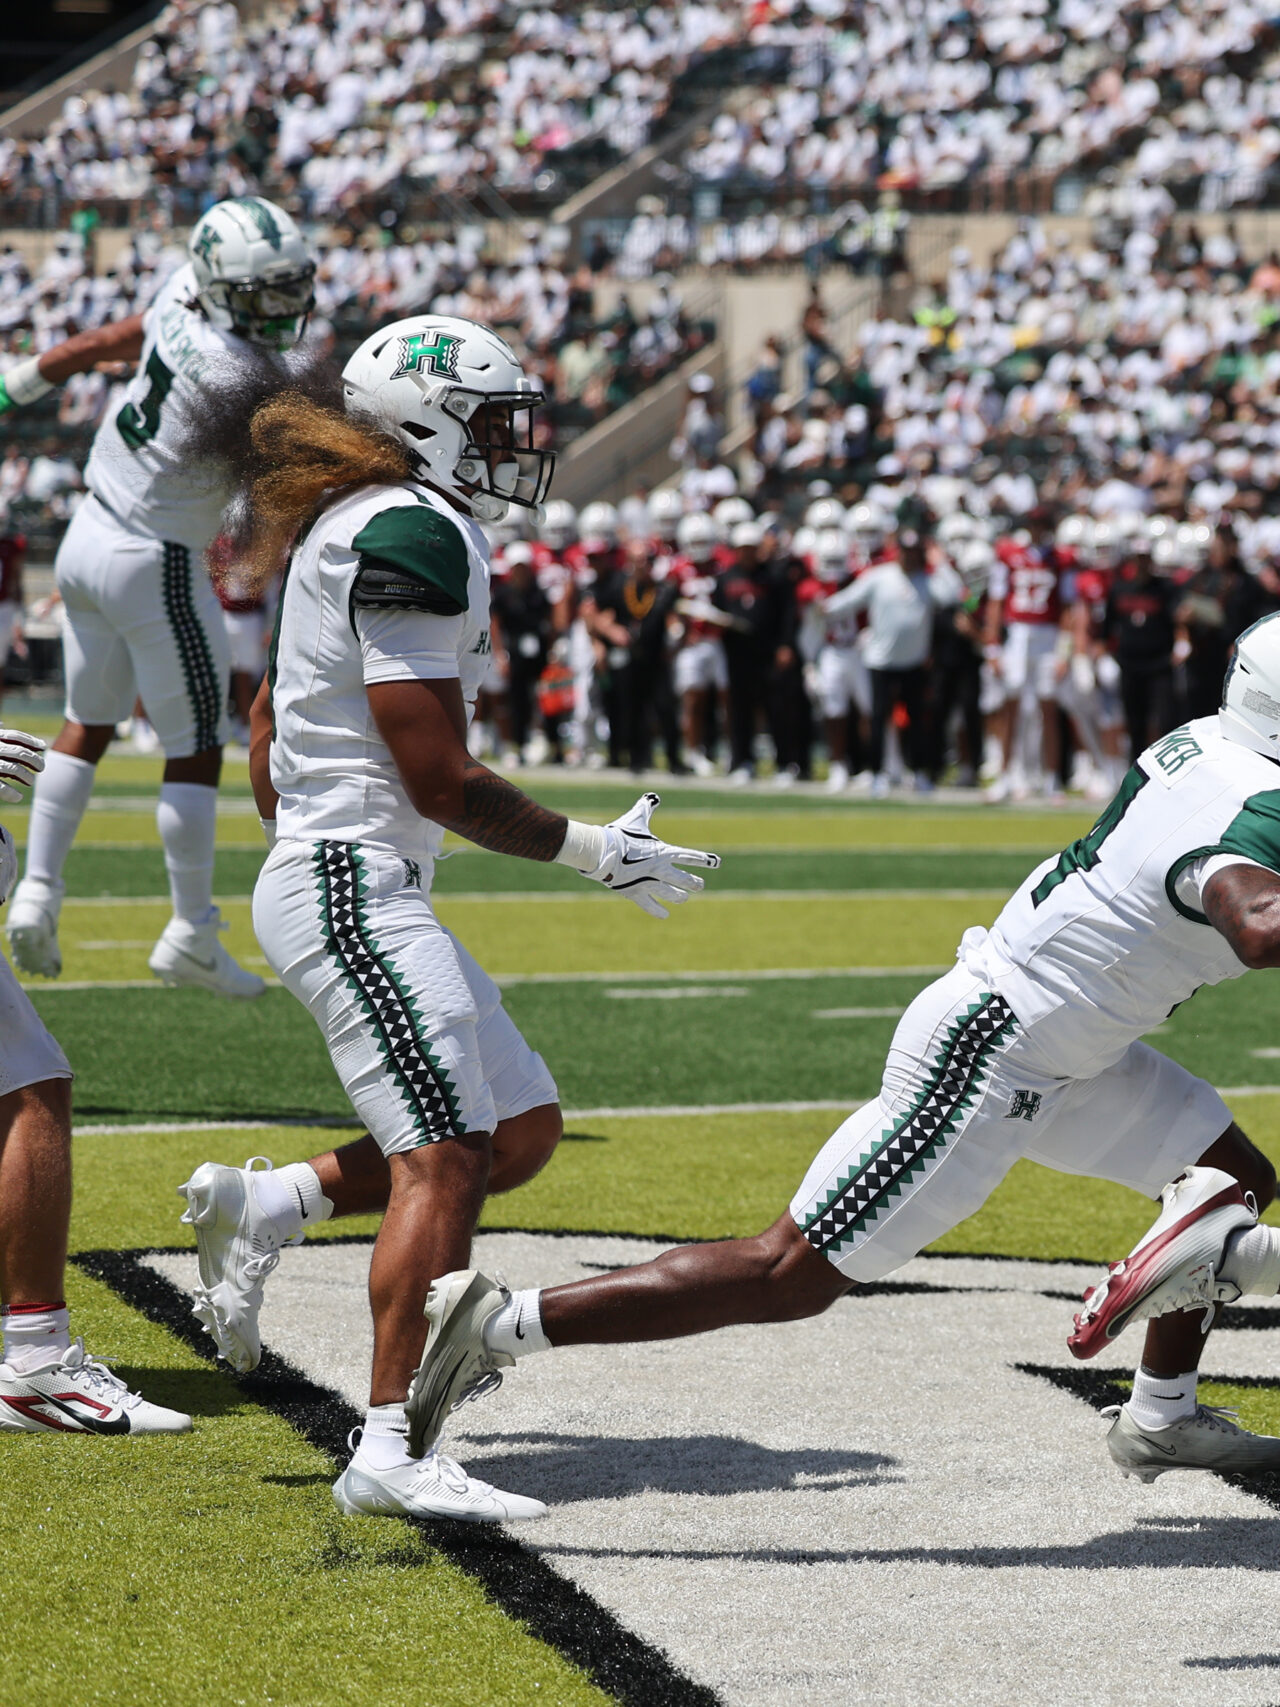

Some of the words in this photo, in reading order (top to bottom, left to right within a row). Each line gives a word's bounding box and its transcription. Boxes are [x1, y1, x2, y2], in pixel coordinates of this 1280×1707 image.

[390, 331, 466, 383] H
[1148, 725, 1203, 776] MER
[1003, 1090, 1042, 1121] H
